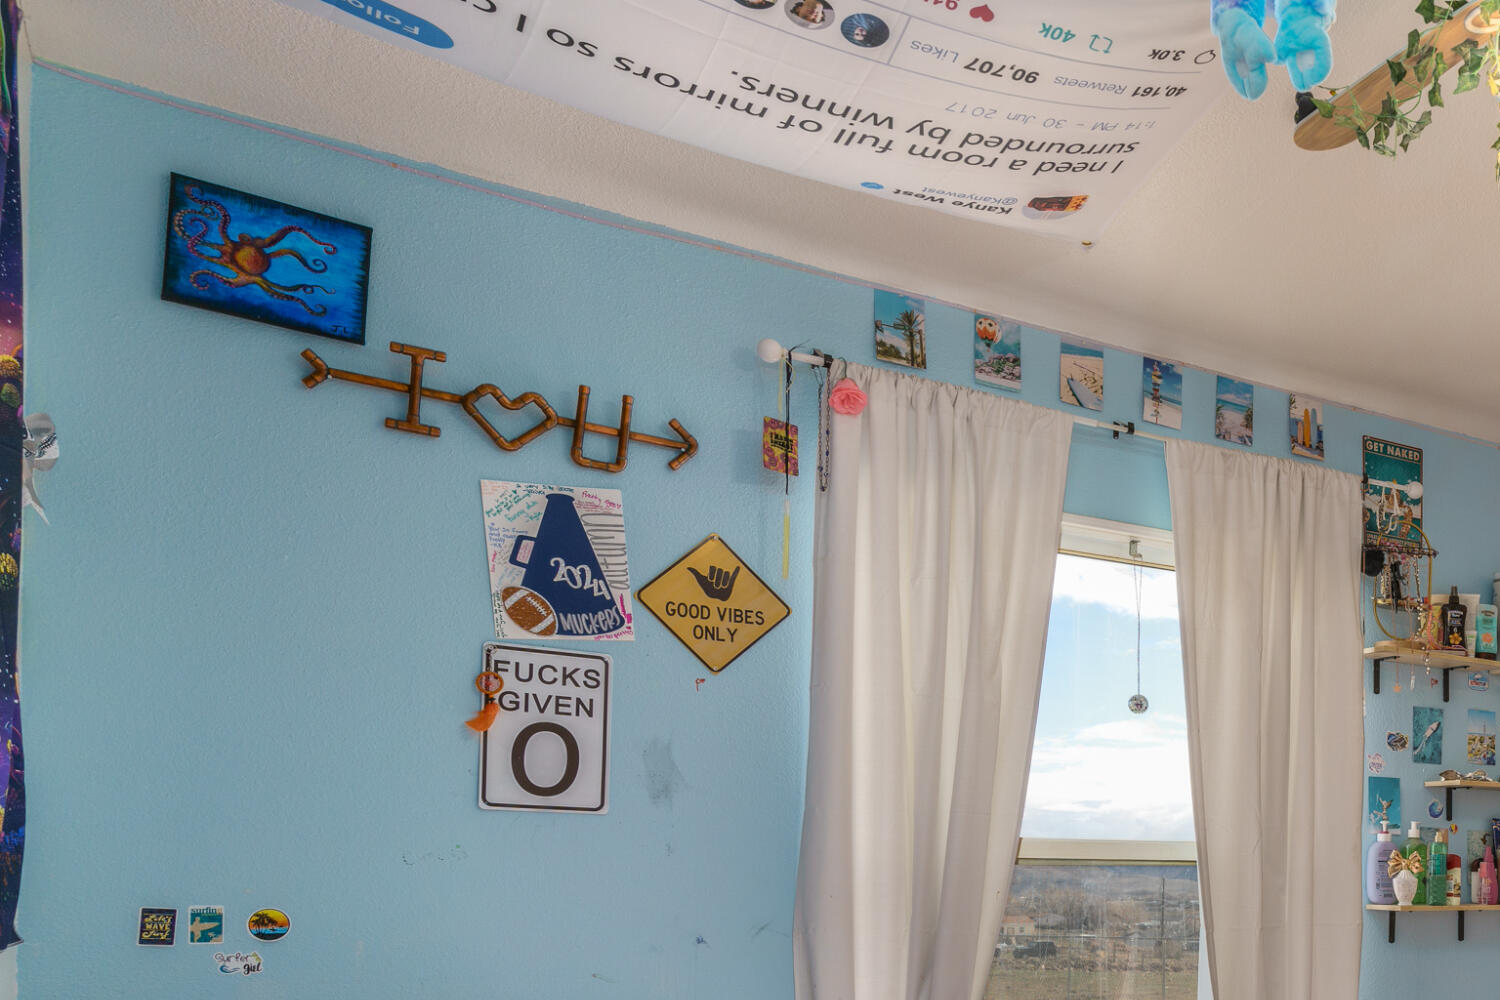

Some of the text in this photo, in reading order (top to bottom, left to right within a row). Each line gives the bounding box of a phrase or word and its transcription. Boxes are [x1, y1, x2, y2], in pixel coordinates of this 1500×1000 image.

[343, 0, 420, 36] Follo
[546, 28, 599, 58] so
[910, 39, 1187, 98] 40,161 Retweets 90,707 Likes
[613, 55, 769, 119] mirrors
[731, 70, 1140, 155] surrounded by winners.
[945, 101, 998, 119] 2017
[1006, 110, 1036, 125] Jun
[1042, 116, 1068, 129] 30
[776, 115, 823, 133] of
[1090, 119, 1120, 132] PM
[833, 129, 893, 154] full
[907, 144, 999, 169] room
[1009, 158, 1027, 171] a
[1033, 160, 1108, 176] need
[1111, 159, 1124, 175] I
[892, 187, 1013, 216] Kanye West
[1366, 440, 1420, 461] GET NAKED
[550, 557, 611, 600] 2024
[665, 600, 766, 626] GOOD VIBES
[692, 624, 738, 643] ONLY
[493, 659, 601, 689] FUCKS
[498, 690, 594, 718] GIVEN
[243, 963, 262, 975] girl
